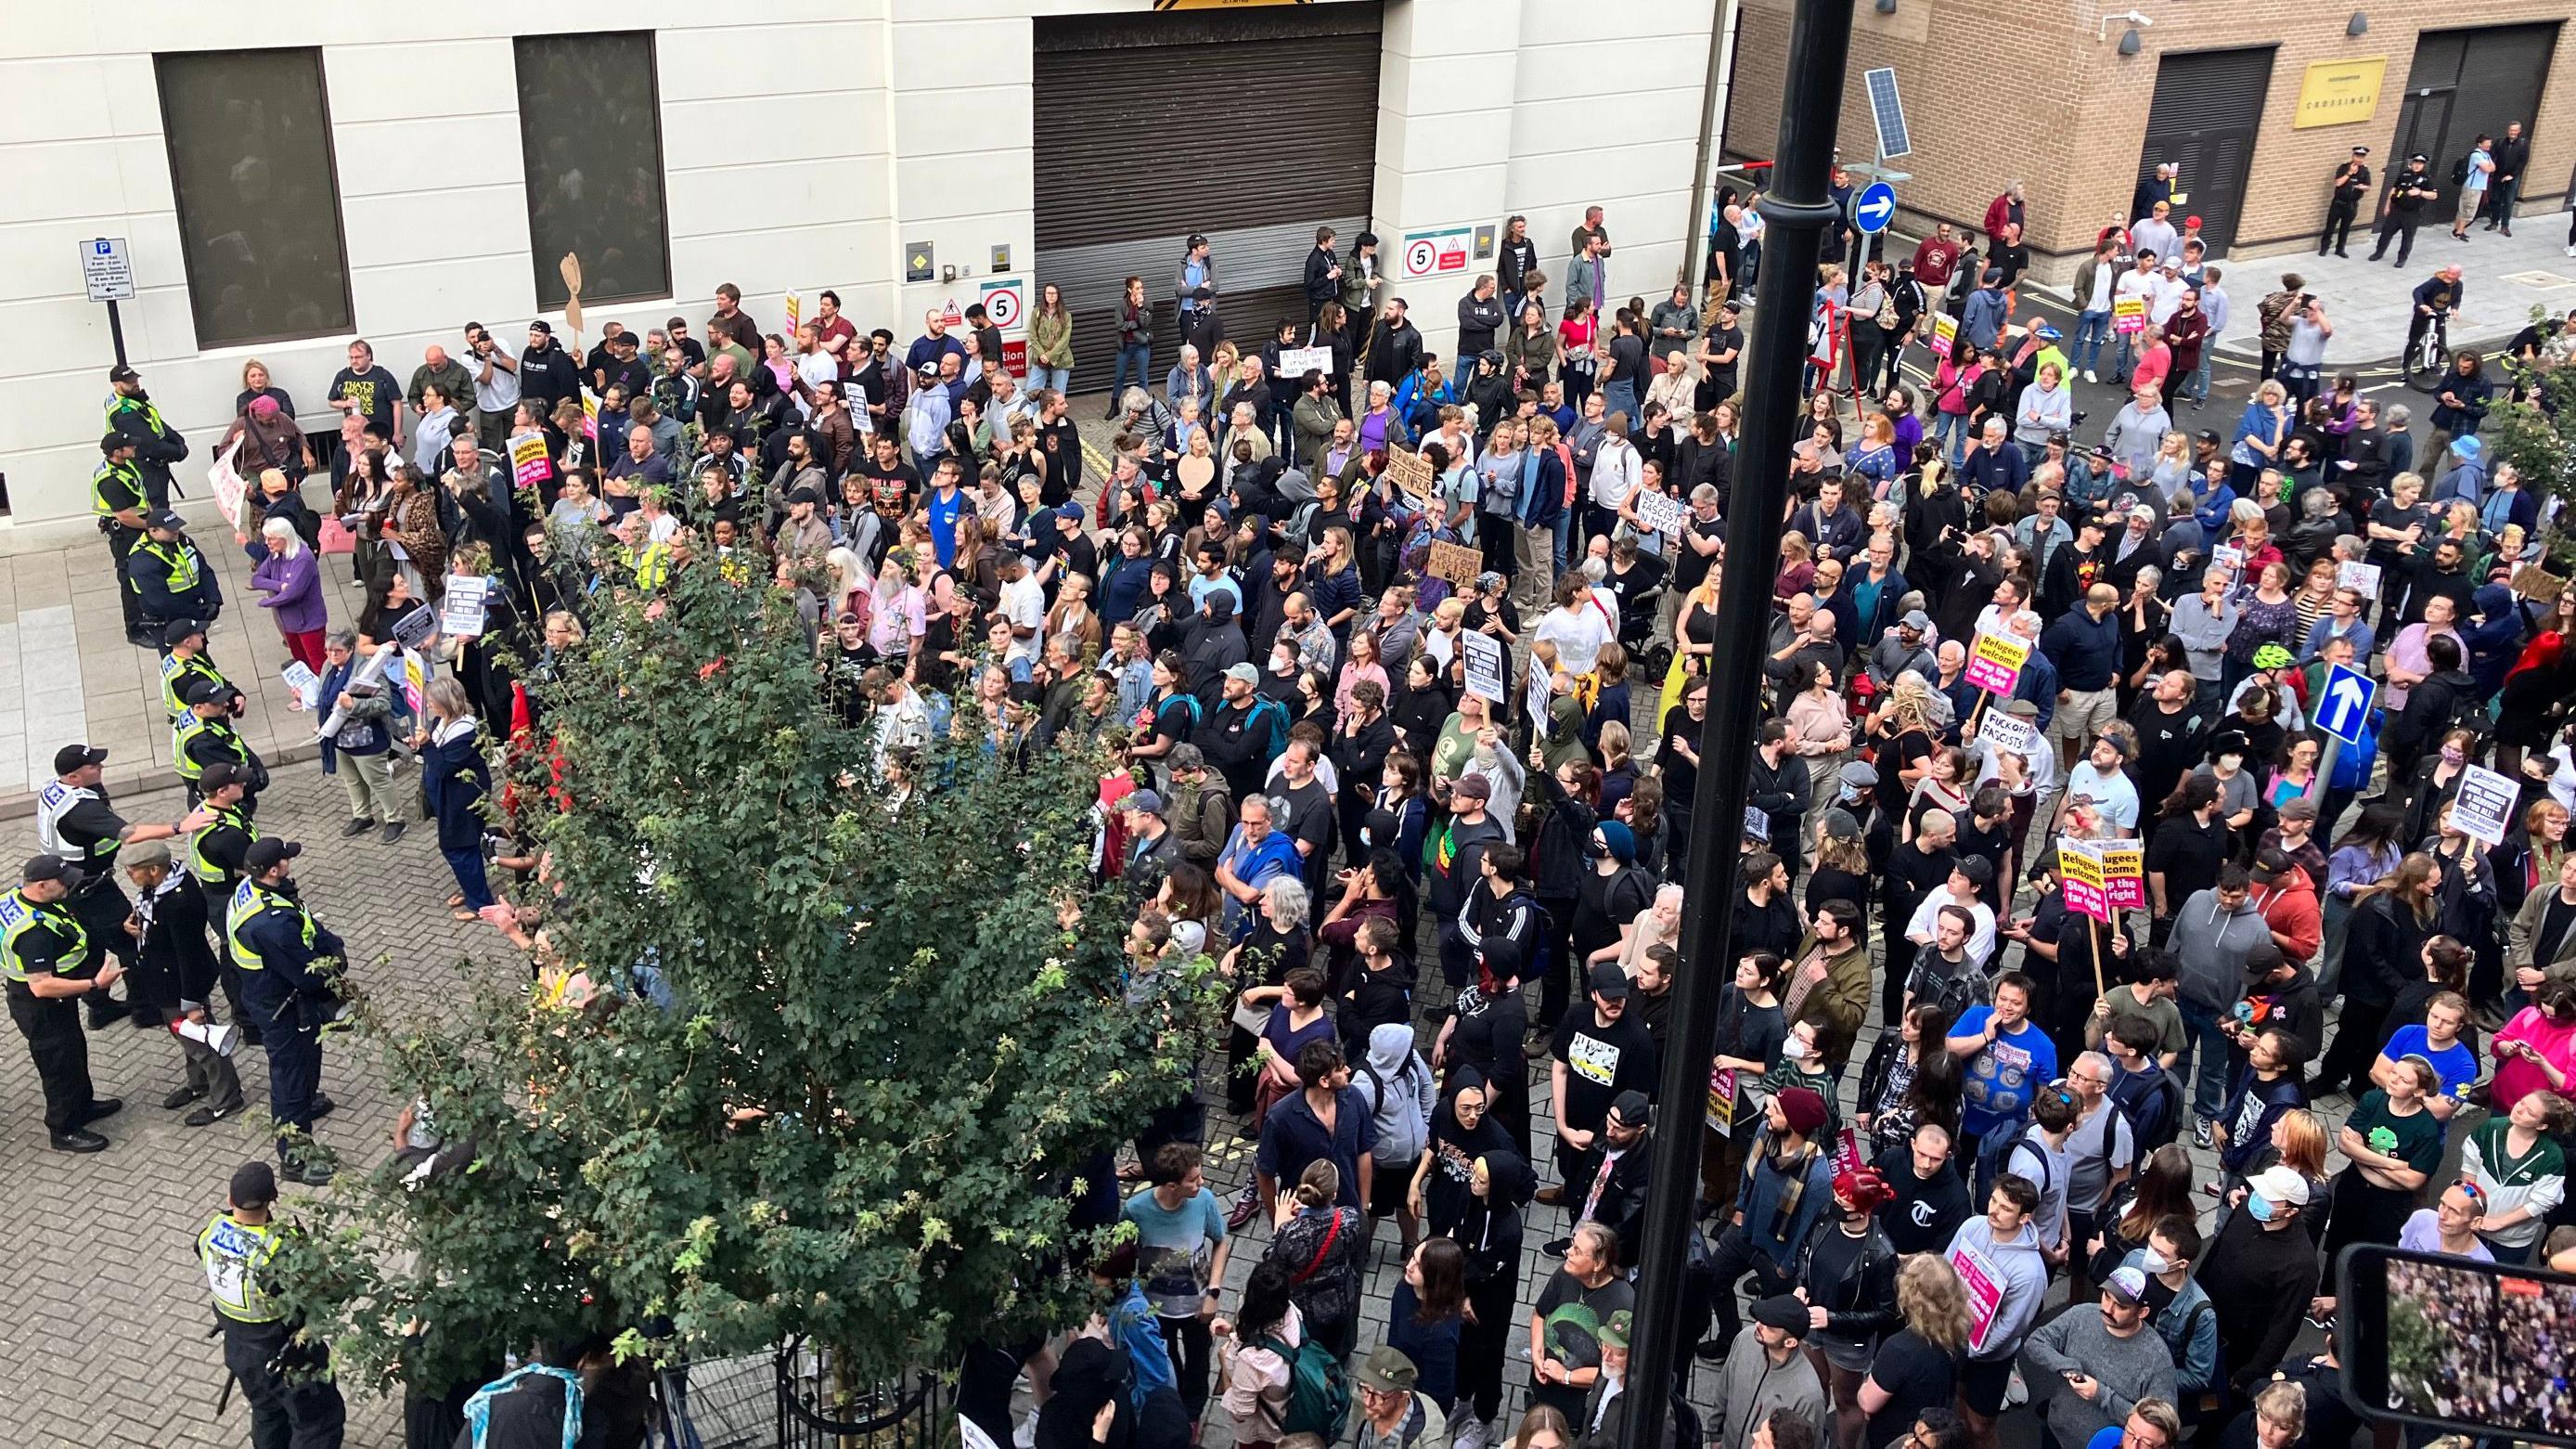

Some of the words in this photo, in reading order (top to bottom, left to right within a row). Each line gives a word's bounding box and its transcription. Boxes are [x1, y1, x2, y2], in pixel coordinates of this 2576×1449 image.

[2307, 96, 2371, 110] CROSSINGS
[1416, 249, 1426, 265] 5
[996, 299, 1007, 317] 5
[1003, 352, 1024, 361] tion
[515, 443, 544, 457] Refugees
[516, 450, 544, 464] welcome
[1407, 473, 1431, 496] NAZIS
[1642, 491, 1656, 503] NO
[1658, 497, 1678, 512] ROO
[1639, 511, 1648, 522] IN
[1650, 517, 1668, 530] MY
[1433, 540, 1481, 561] REFUGEES
[1429, 559, 1478, 577] FASCISTS
[1445, 572, 1470, 584] OUT
[1979, 646, 2017, 667] welcome
[1983, 637, 2023, 659] Refugees
[1970, 667, 1984, 679] far
[1984, 674, 2007, 689] right
[1974, 657, 1995, 673] Stop
[1996, 666, 2011, 679] the
[1990, 714, 2011, 730] FUCK
[2012, 724, 2029, 735] OFF
[1982, 724, 2024, 749] FASCISTS
[2456, 807, 2477, 820] SMASH
[2478, 817, 2501, 830] RACISM
[2062, 853, 2101, 874] Refugees
[2104, 866, 2137, 874] lcome
[2105, 855, 2138, 865] ugees
[2064, 866, 2101, 886] welcome
[2117, 879, 2136, 888] the
[2066, 880, 2088, 896] Stop
[2088, 886, 2101, 900] the
[2109, 890, 2136, 901] right
[2067, 892, 2082, 903] far
[2084, 898, 2103, 913] right
[1711, 1078, 1731, 1099] Stop
[1719, 1073, 1732, 1088] far
[1709, 1093, 1729, 1111] welc
[1709, 1104, 1729, 1123] Refu
[1836, 1135, 1850, 1161] right
[1829, 1158, 1841, 1179] top
